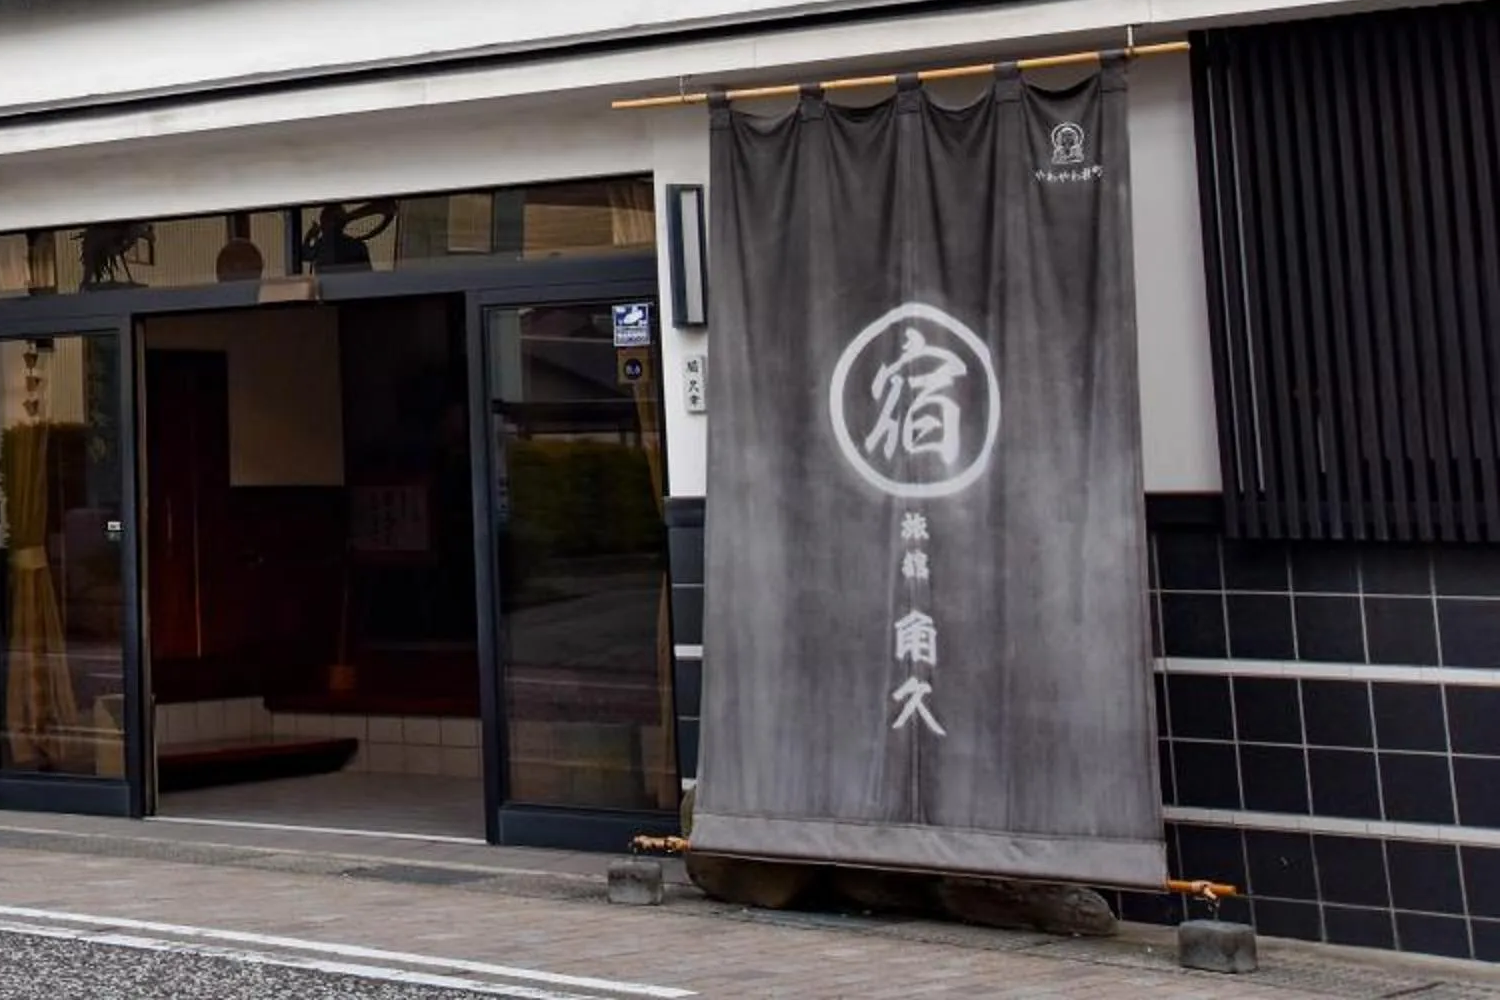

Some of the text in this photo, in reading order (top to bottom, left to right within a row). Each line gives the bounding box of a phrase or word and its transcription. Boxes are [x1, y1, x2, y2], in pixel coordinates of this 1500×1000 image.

[865, 327, 967, 466] 宿
[892, 512, 946, 736] 旅館 角久
